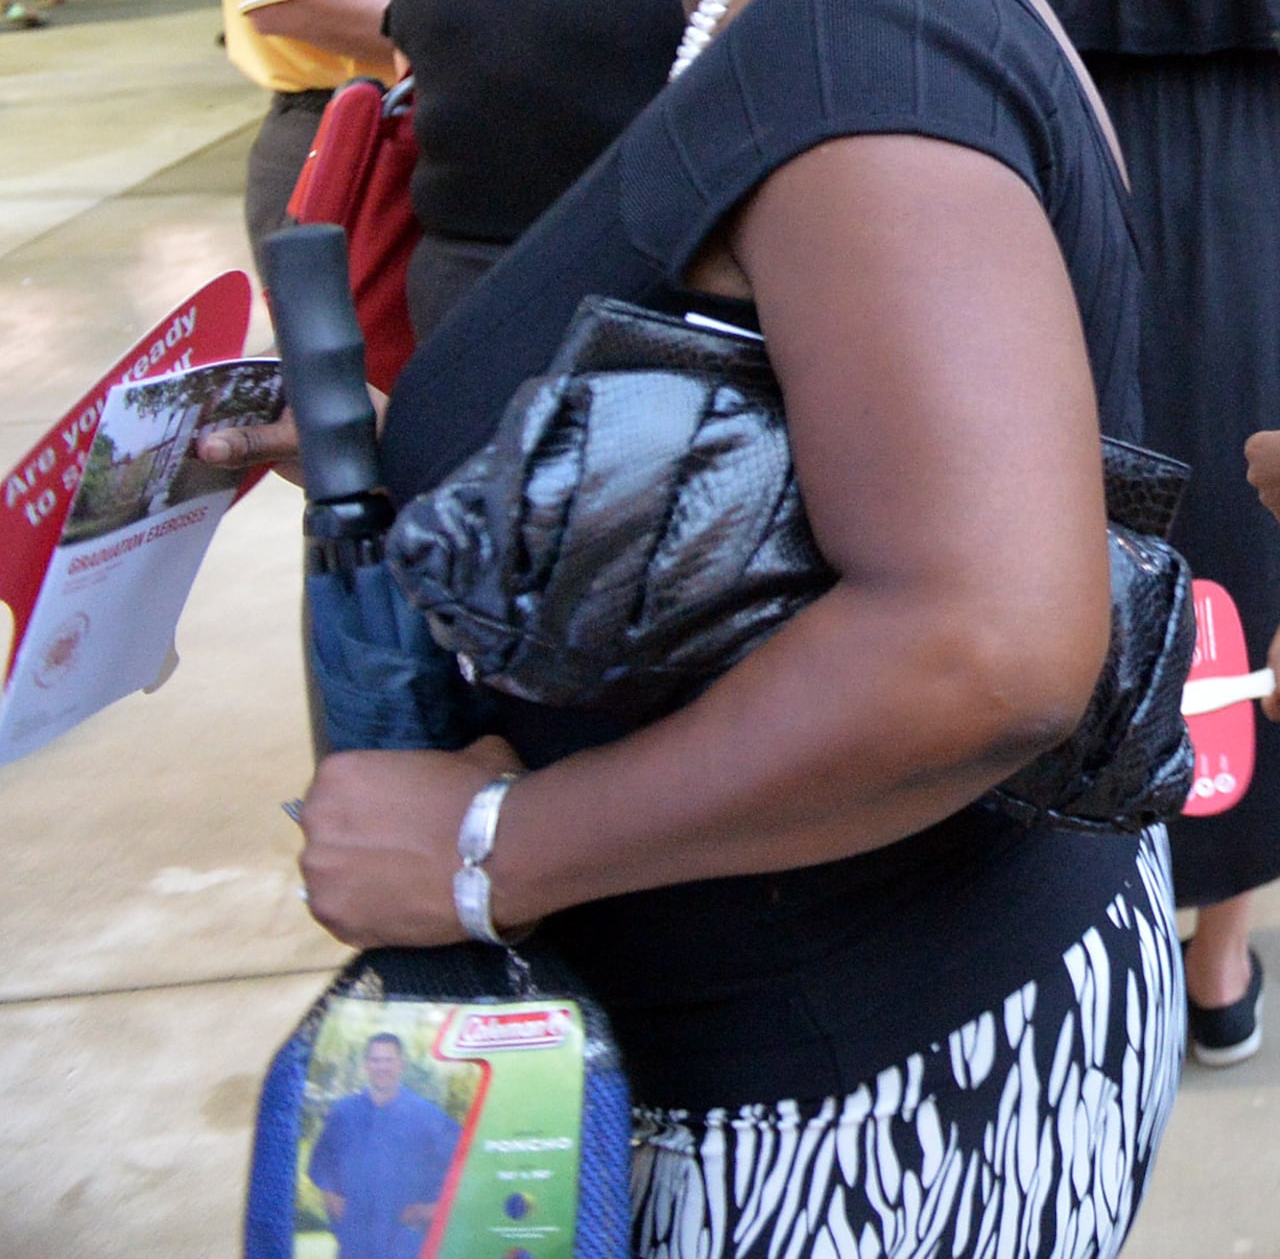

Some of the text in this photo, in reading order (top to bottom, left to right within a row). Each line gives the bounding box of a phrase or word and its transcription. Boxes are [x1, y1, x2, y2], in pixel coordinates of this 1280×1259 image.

[5, 446, 57, 509] Are
[121, 305, 197, 385] ready
[25, 488, 57, 527] to
